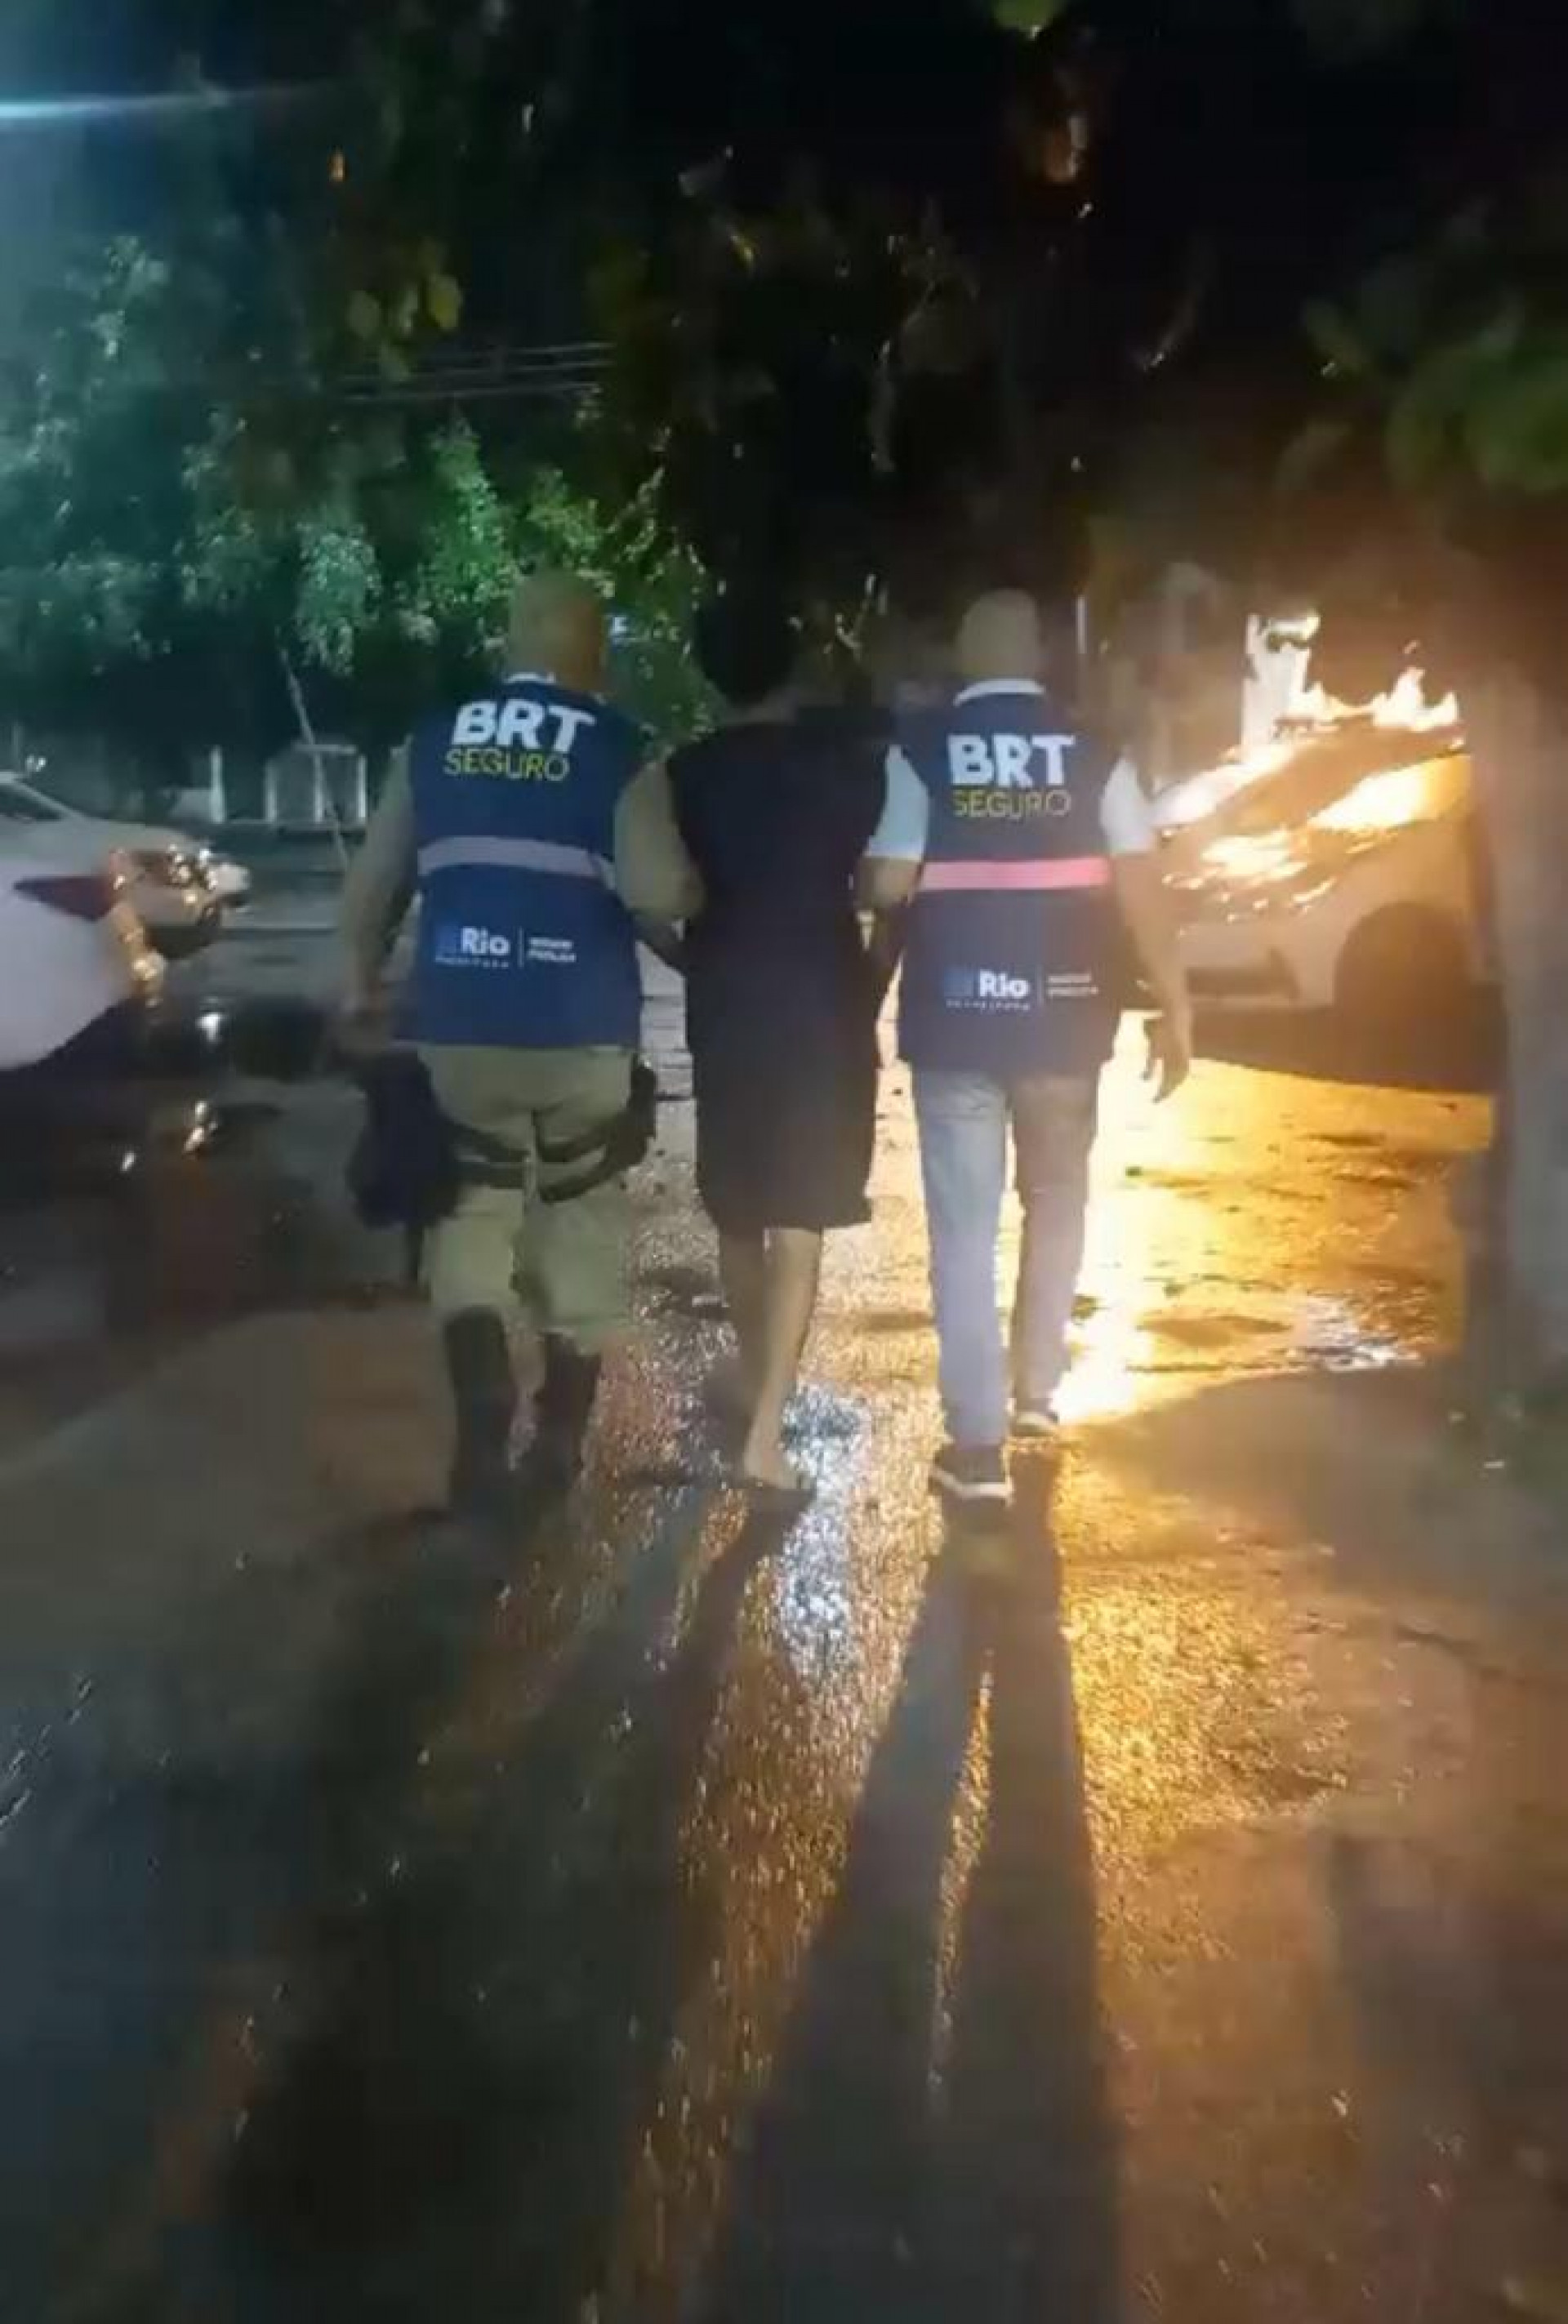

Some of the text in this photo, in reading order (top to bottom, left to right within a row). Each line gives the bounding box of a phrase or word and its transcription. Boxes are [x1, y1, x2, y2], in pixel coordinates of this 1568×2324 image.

[452, 699, 597, 752] BRT
[443, 747, 570, 781] SEGURO
[947, 733, 1076, 787] BRT
[461, 926, 511, 955] Rio
[979, 969, 1030, 999] Rio
